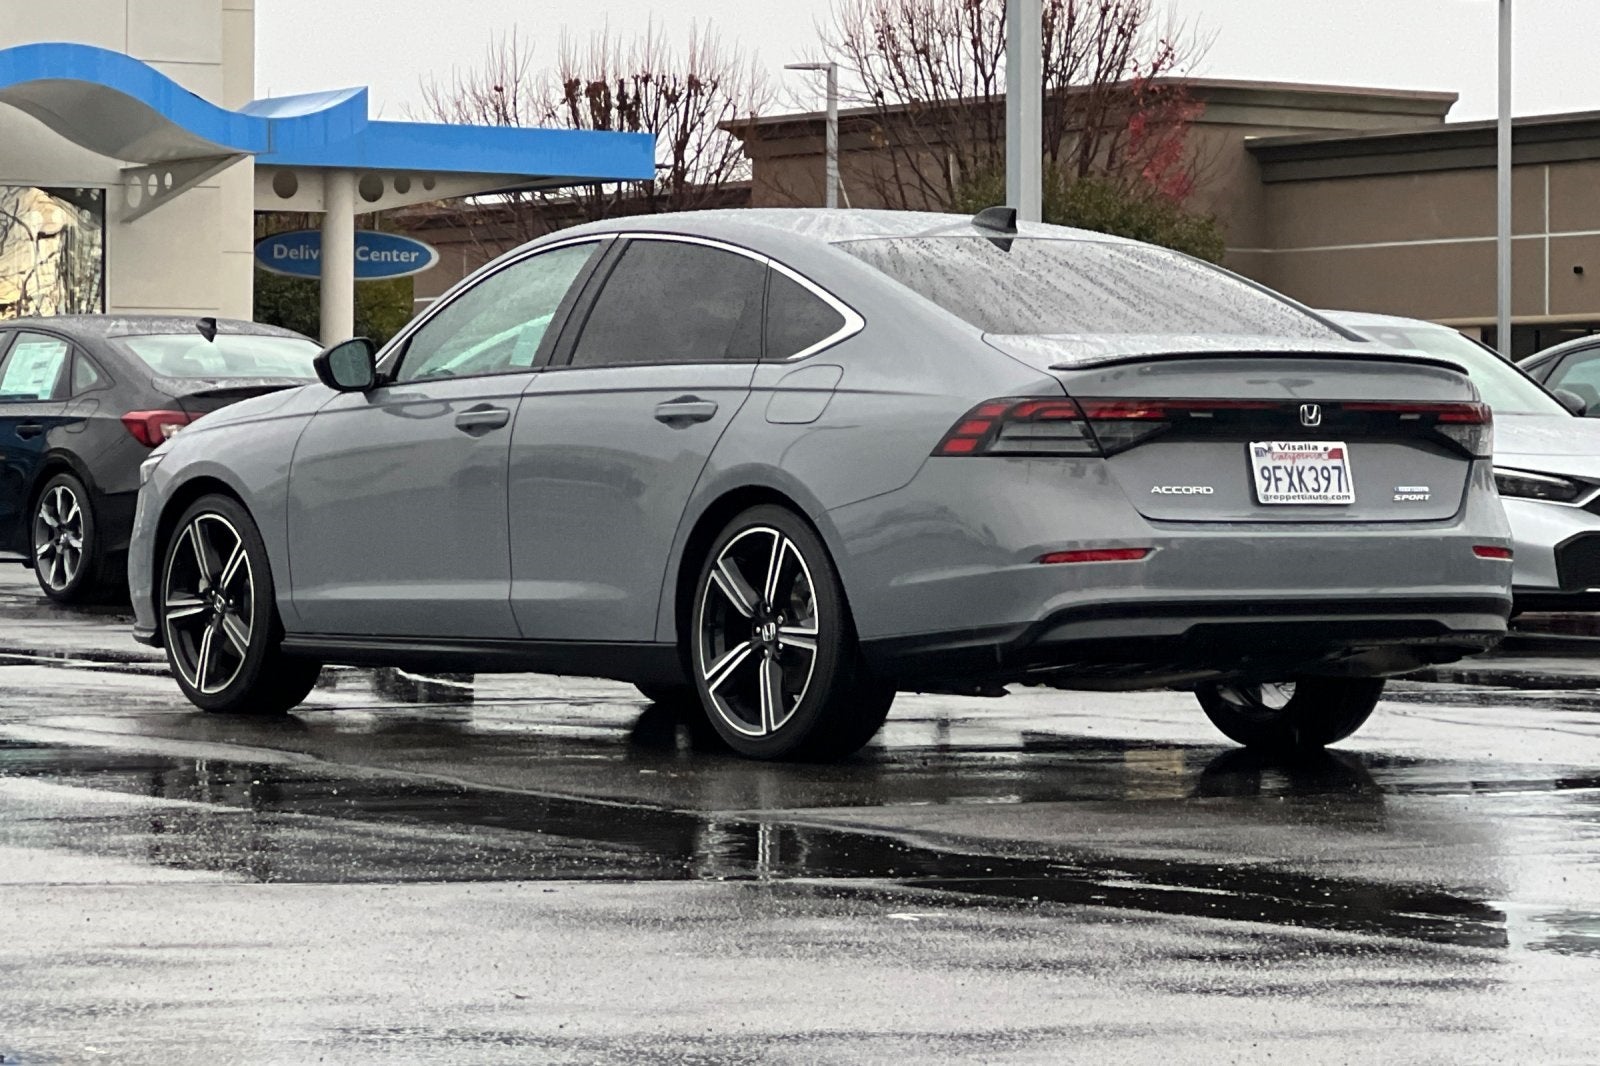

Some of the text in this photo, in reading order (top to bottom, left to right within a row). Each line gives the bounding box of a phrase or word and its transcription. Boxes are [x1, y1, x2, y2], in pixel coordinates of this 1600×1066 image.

[273, 244, 419, 262] Deliv Center
[1278, 443, 1318, 451] Visalia
[1260, 465, 1343, 493] 9FXK397
[1151, 486, 1214, 494] ACCORD
